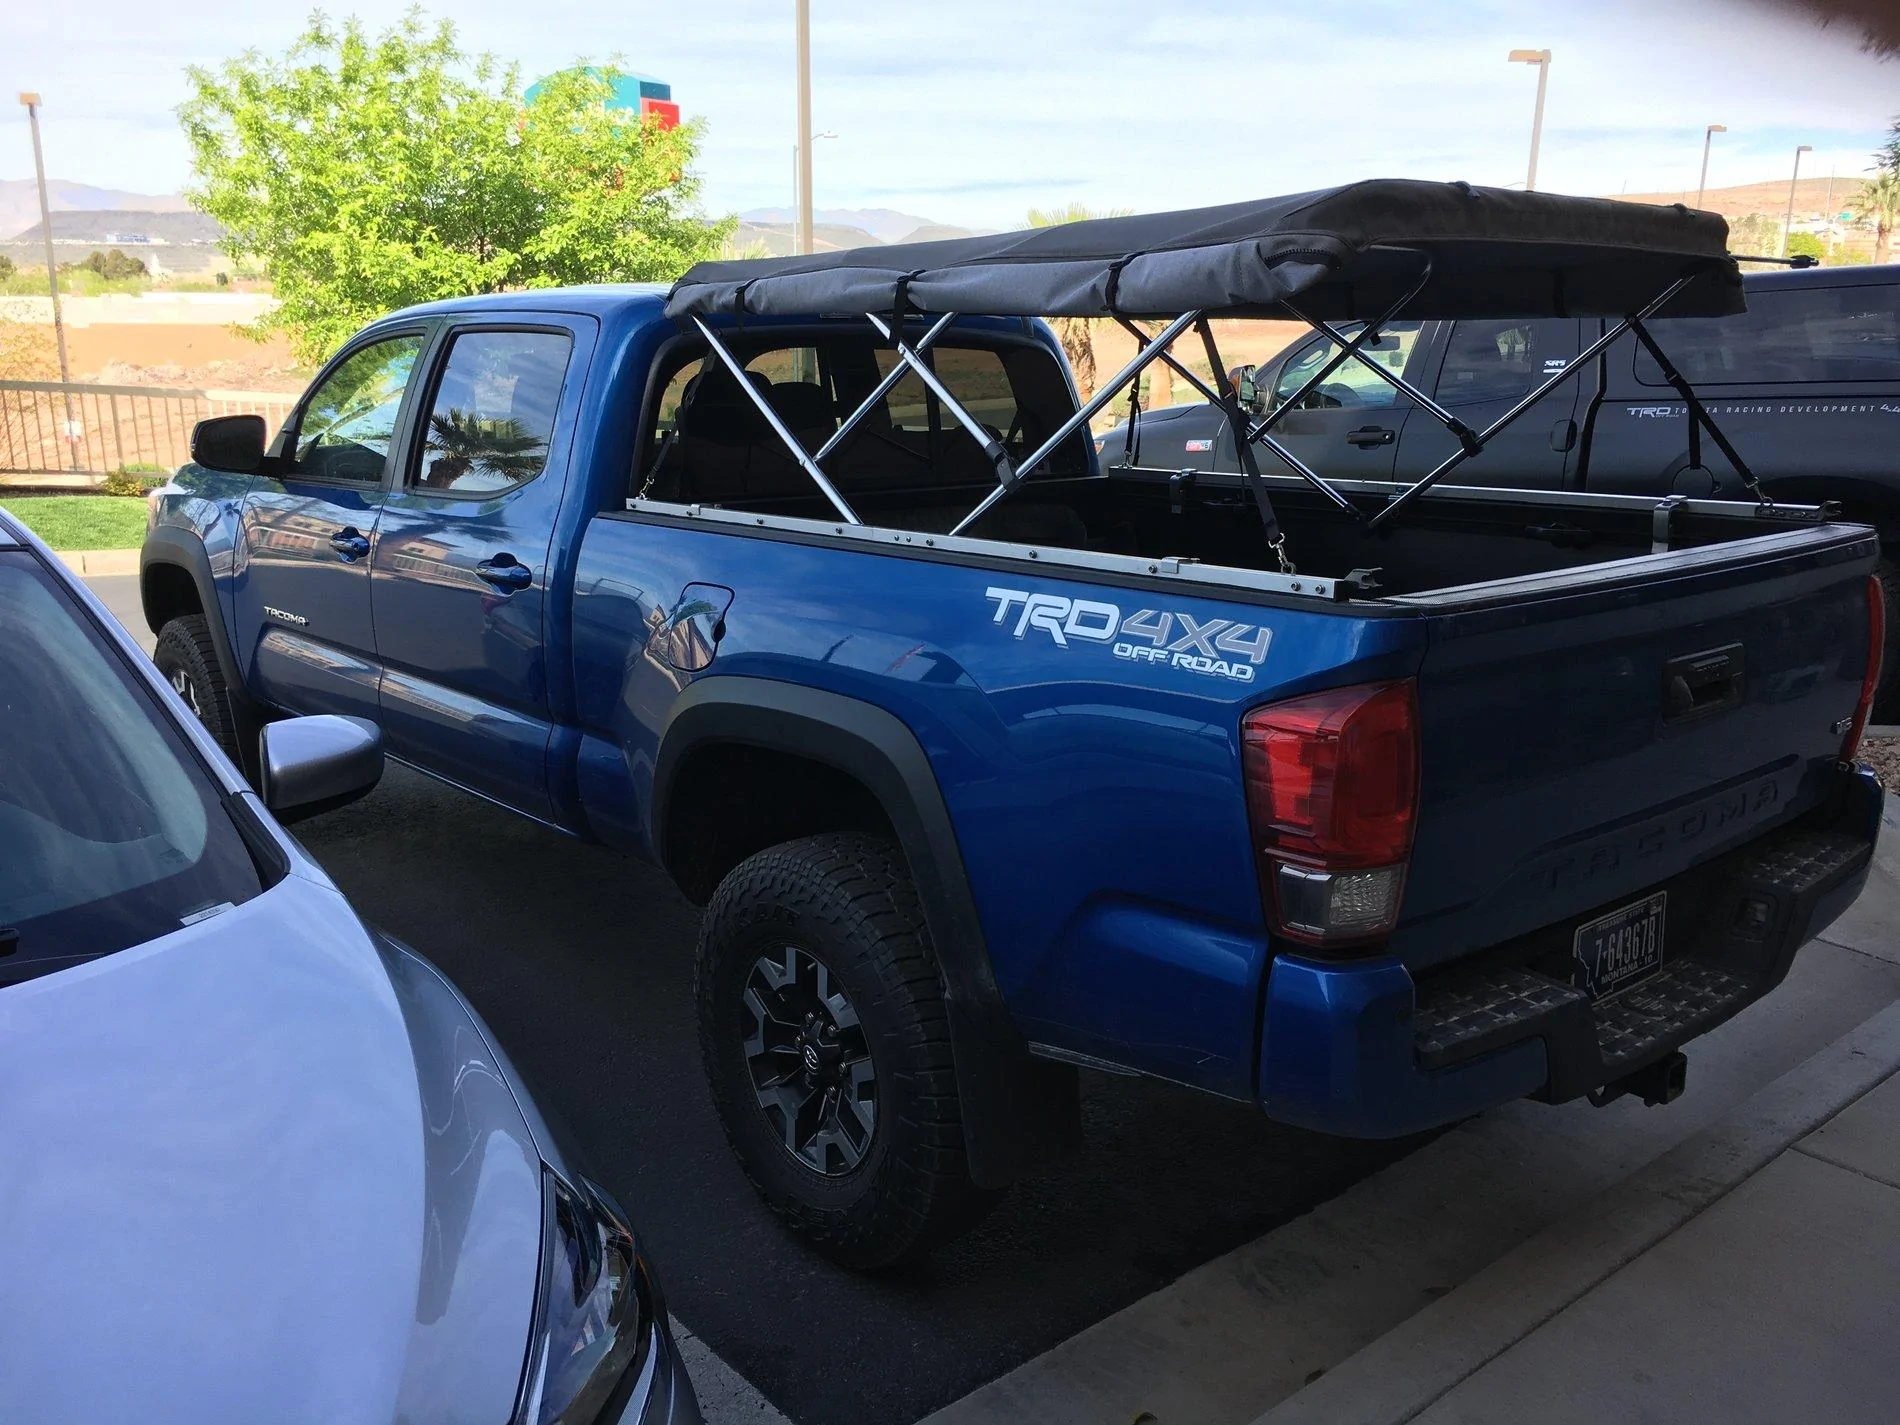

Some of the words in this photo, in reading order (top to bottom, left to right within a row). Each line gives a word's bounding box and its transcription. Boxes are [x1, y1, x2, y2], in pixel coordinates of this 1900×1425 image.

[1626, 406, 1672, 418] TRD
[1674, 406, 1718, 414] TOTA
[1726, 406, 1772, 414] RACING
[1780, 405, 1876, 413] DEVELOPMENT
[263, 605, 308, 627] TACOMA
[985, 586, 1122, 649] TRD
[1112, 641, 1169, 664] OFF
[1171, 652, 1256, 683] ROAD
[1528, 779, 1779, 890] TACOMA
[1600, 961, 1639, 985] MONTANA
